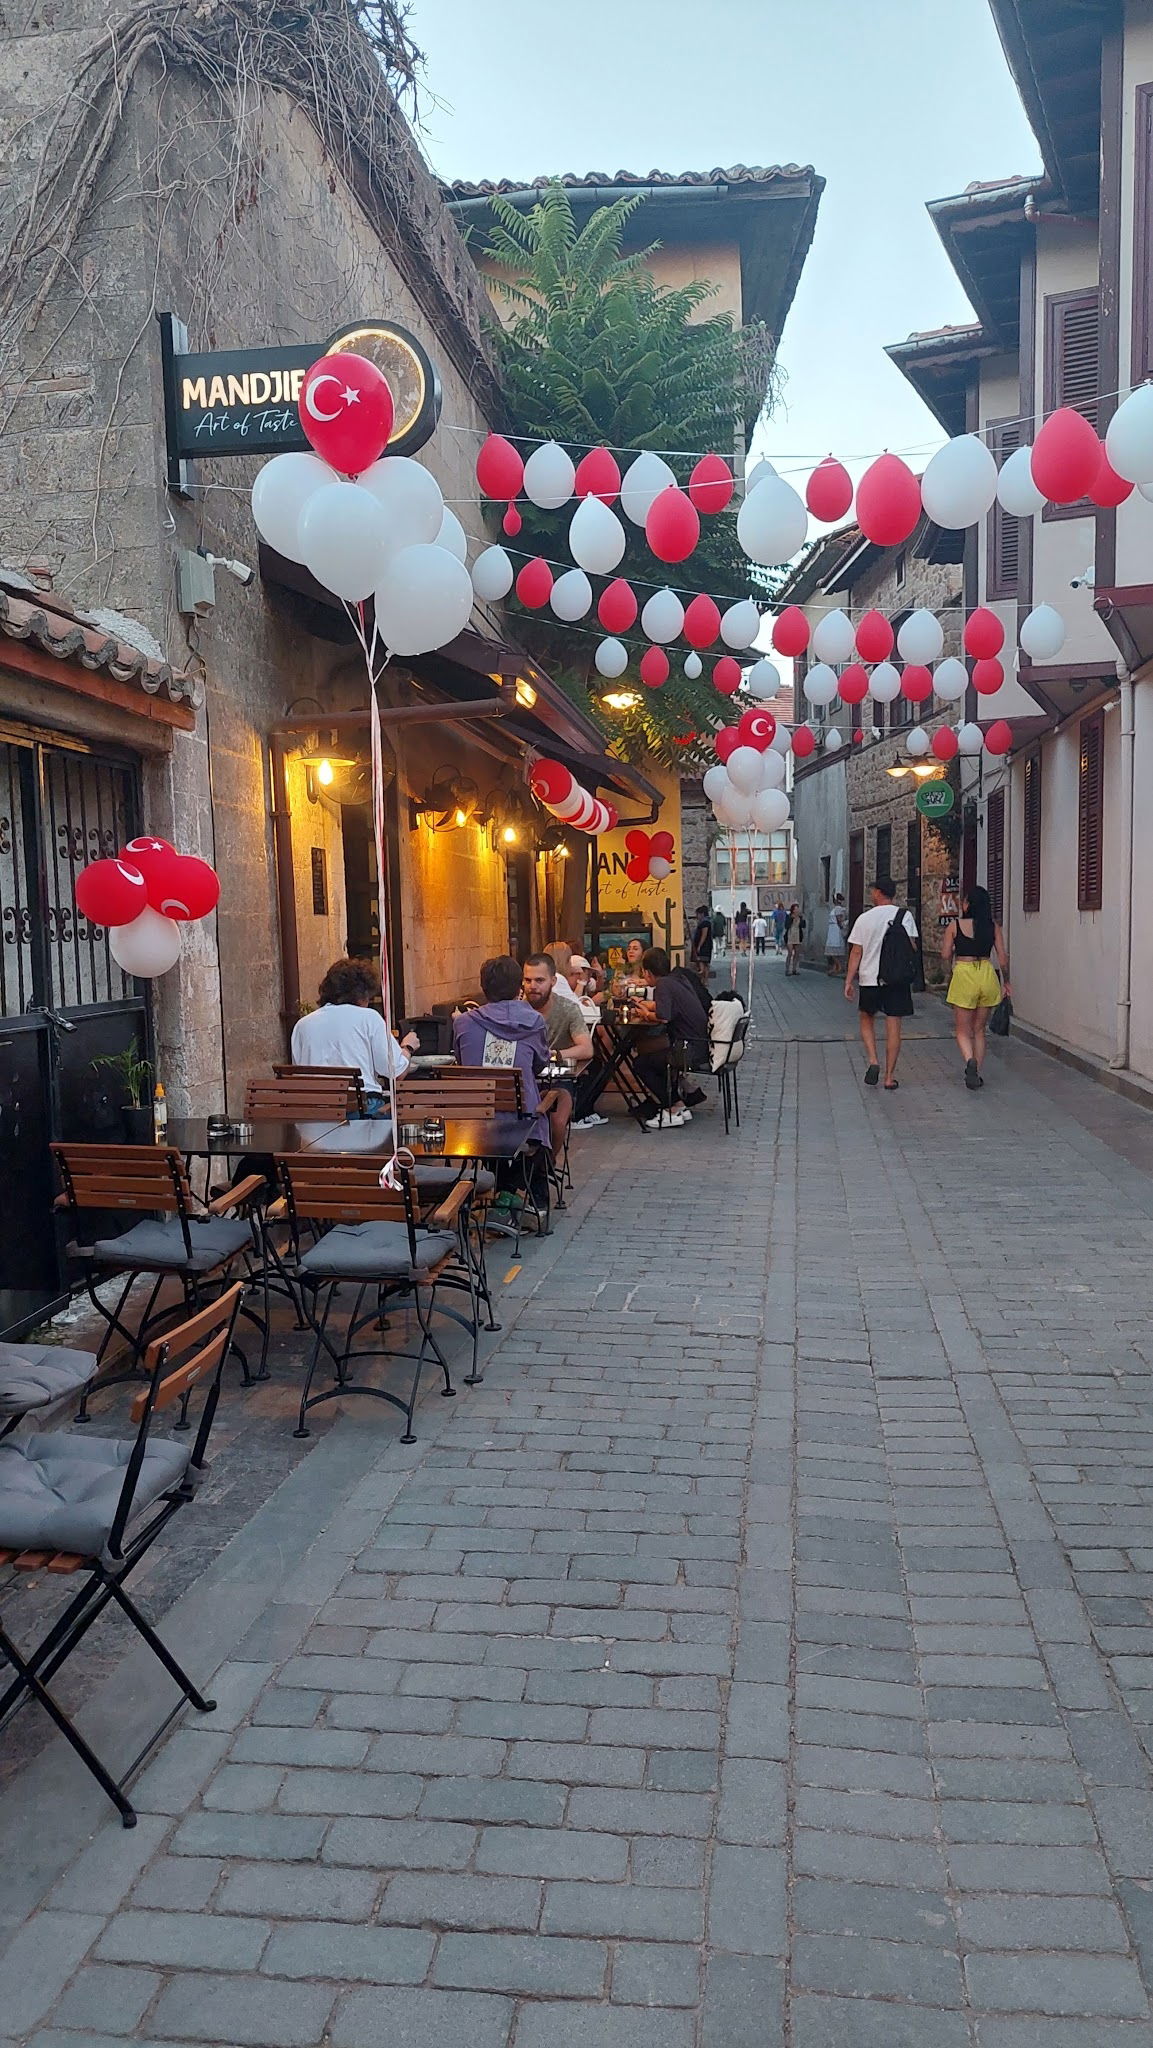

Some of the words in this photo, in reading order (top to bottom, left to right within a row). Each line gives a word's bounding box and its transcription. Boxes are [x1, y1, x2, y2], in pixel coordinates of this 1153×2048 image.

[182, 369, 305, 409] MANDJIE
[193, 411, 230, 437] Art
[233, 412, 251, 436] of
[253, 409, 299, 433] Taste
[615, 881, 629, 899] of
[630, 880, 668, 897] Taste
